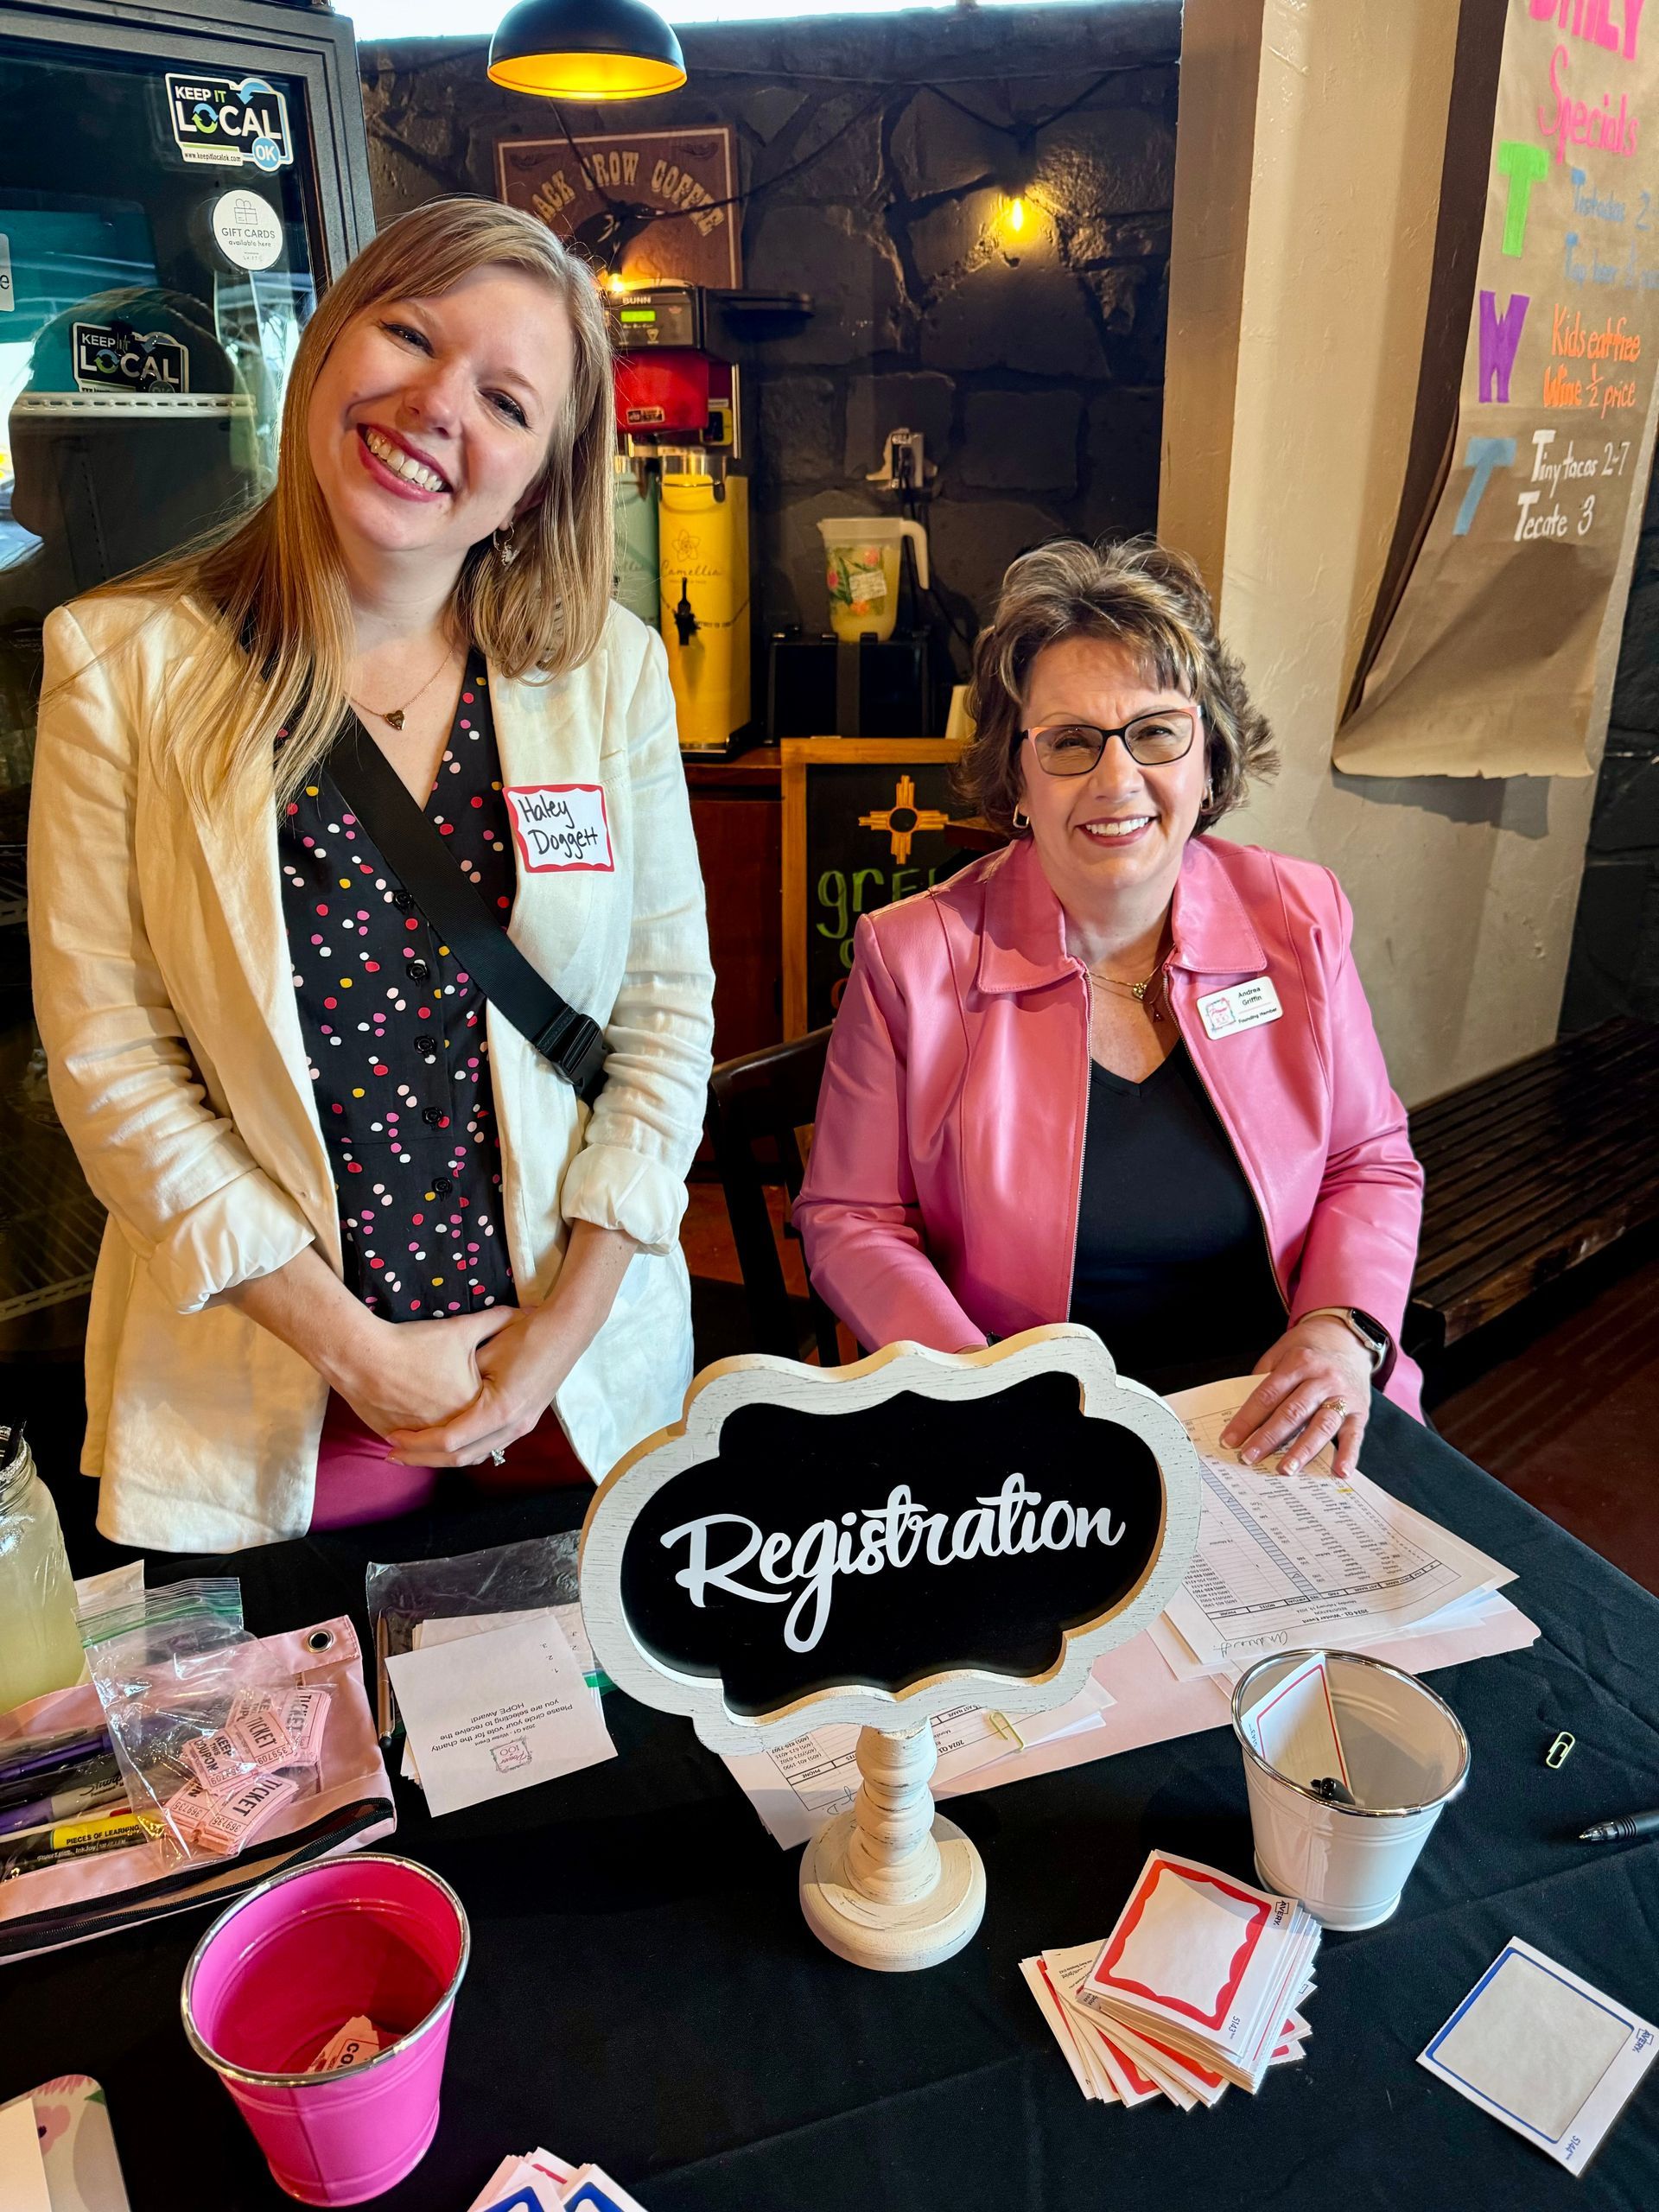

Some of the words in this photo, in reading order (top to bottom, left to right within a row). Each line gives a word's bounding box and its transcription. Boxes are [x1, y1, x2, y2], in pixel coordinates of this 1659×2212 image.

[175, 86, 212, 101] KEEP
[213, 90, 226, 103] IT
[1538, 44, 1640, 165] Specials
[175, 101, 282, 139] LOCAL
[255, 145, 276, 162] OK
[532, 170, 575, 223] ACK
[1497, 141, 1549, 258] T
[221, 228, 242, 238] GIFT
[245, 229, 276, 238] CARDS
[81, 334, 116, 348] KEEP
[1551, 303, 1586, 359] Kids
[1611, 316, 1641, 363] free
[1478, 289, 1530, 403] W
[80, 346, 180, 384] LOCAL
[1600, 380, 1637, 419] price
[1531, 429, 1562, 499] Tiny
[1563, 441, 1598, 476] tacos
[1452, 437, 1517, 536] T
[1514, 490, 1567, 543] Tecate
[1577, 494, 1596, 536] 3
[518, 794, 575, 830] Haley
[527, 827, 598, 860] Doggett
[1238, 987, 1262, 998] Andrea
[1242, 995, 1262, 1006] Griffin
[660, 1472, 1126, 1653] Registration
[499, 1702, 524, 1712] HOPE
[544, 1698, 559, 1707] you
[546, 1703, 573, 1716] Please
[471, 1710, 498, 1724] Award!
[494, 1709, 529, 1724] selecting
[505, 1719, 524, 1729] your
[524, 1713, 545, 1723] circle
[245, 1716, 277, 1748] TICKET
[454, 1725, 483, 1737] receive
[487, 1726, 504, 1735] vote
[523, 1723, 536, 1732] 2024
[209, 1744, 220, 1756] THIS
[215, 1735, 232, 1756] KEEP
[431, 1739, 458, 1752] charity
[948, 1739, 965, 1750] 2024
[194, 1739, 219, 1772] COUPON
[802, 1768, 821, 1778] PHONE
[232, 1779, 283, 1817] TICKET
[173, 1801, 202, 1817] 369735
[212, 1816, 241, 1832] 369735
[66, 1834, 92, 1845] PIECES
[105, 1825, 140, 1837] LEARNING
[1228, 2016, 1241, 2034] 5143
[1565, 2135, 1580, 2155] 5144
